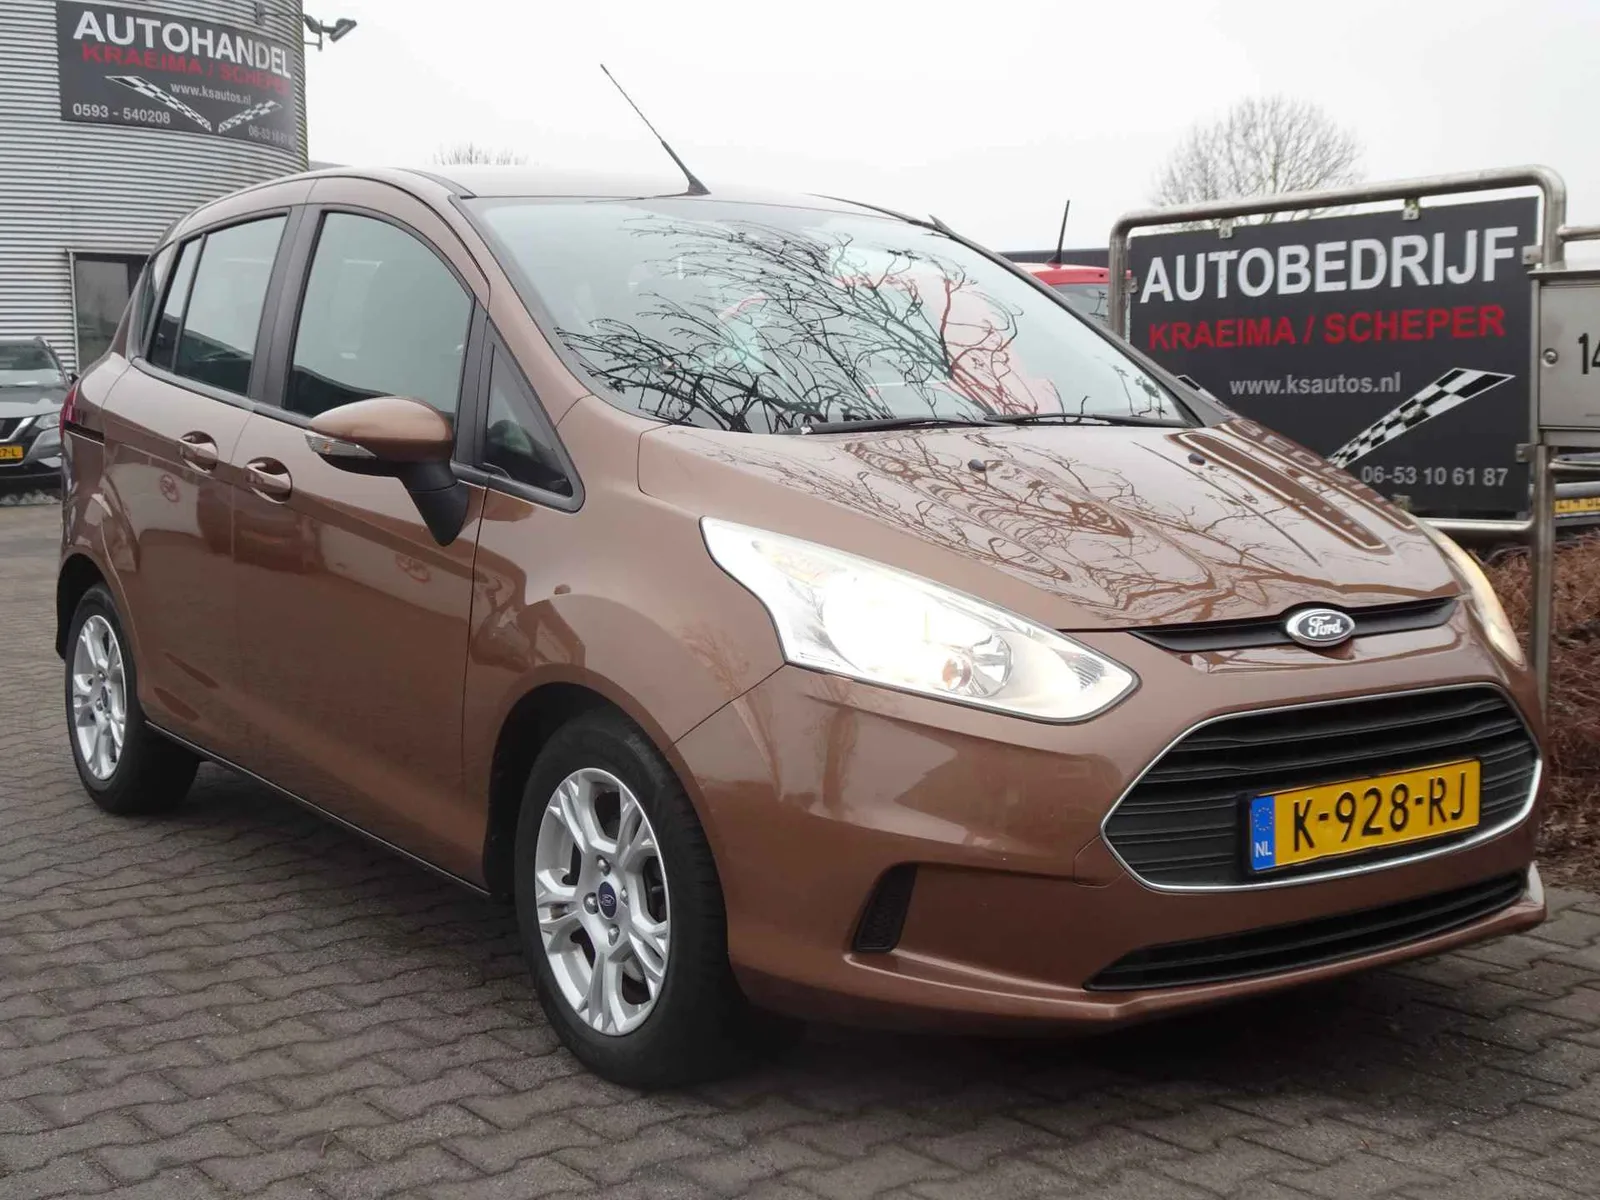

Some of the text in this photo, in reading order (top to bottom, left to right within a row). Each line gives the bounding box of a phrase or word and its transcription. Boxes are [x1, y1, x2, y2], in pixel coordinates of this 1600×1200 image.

[73, 11, 291, 79] AUTOHANDEL
[82, 41, 203, 75] KRAEIMA
[170, 82, 251, 105] www.ksautos.nl
[73, 103, 109, 118] 0593
[123, 107, 171, 125] 540208
[1140, 226, 1518, 304] AUTOBEDRIJF
[1149, 305, 1507, 352] KRAEIMA / SCHEPER
[1229, 372, 1401, 396] www.ksautos.nl
[1361, 466, 1508, 487] 06-53 10 61 87
[1308, 615, 1343, 638] Ford
[1255, 772, 1466, 858] NL K-928-RJ
